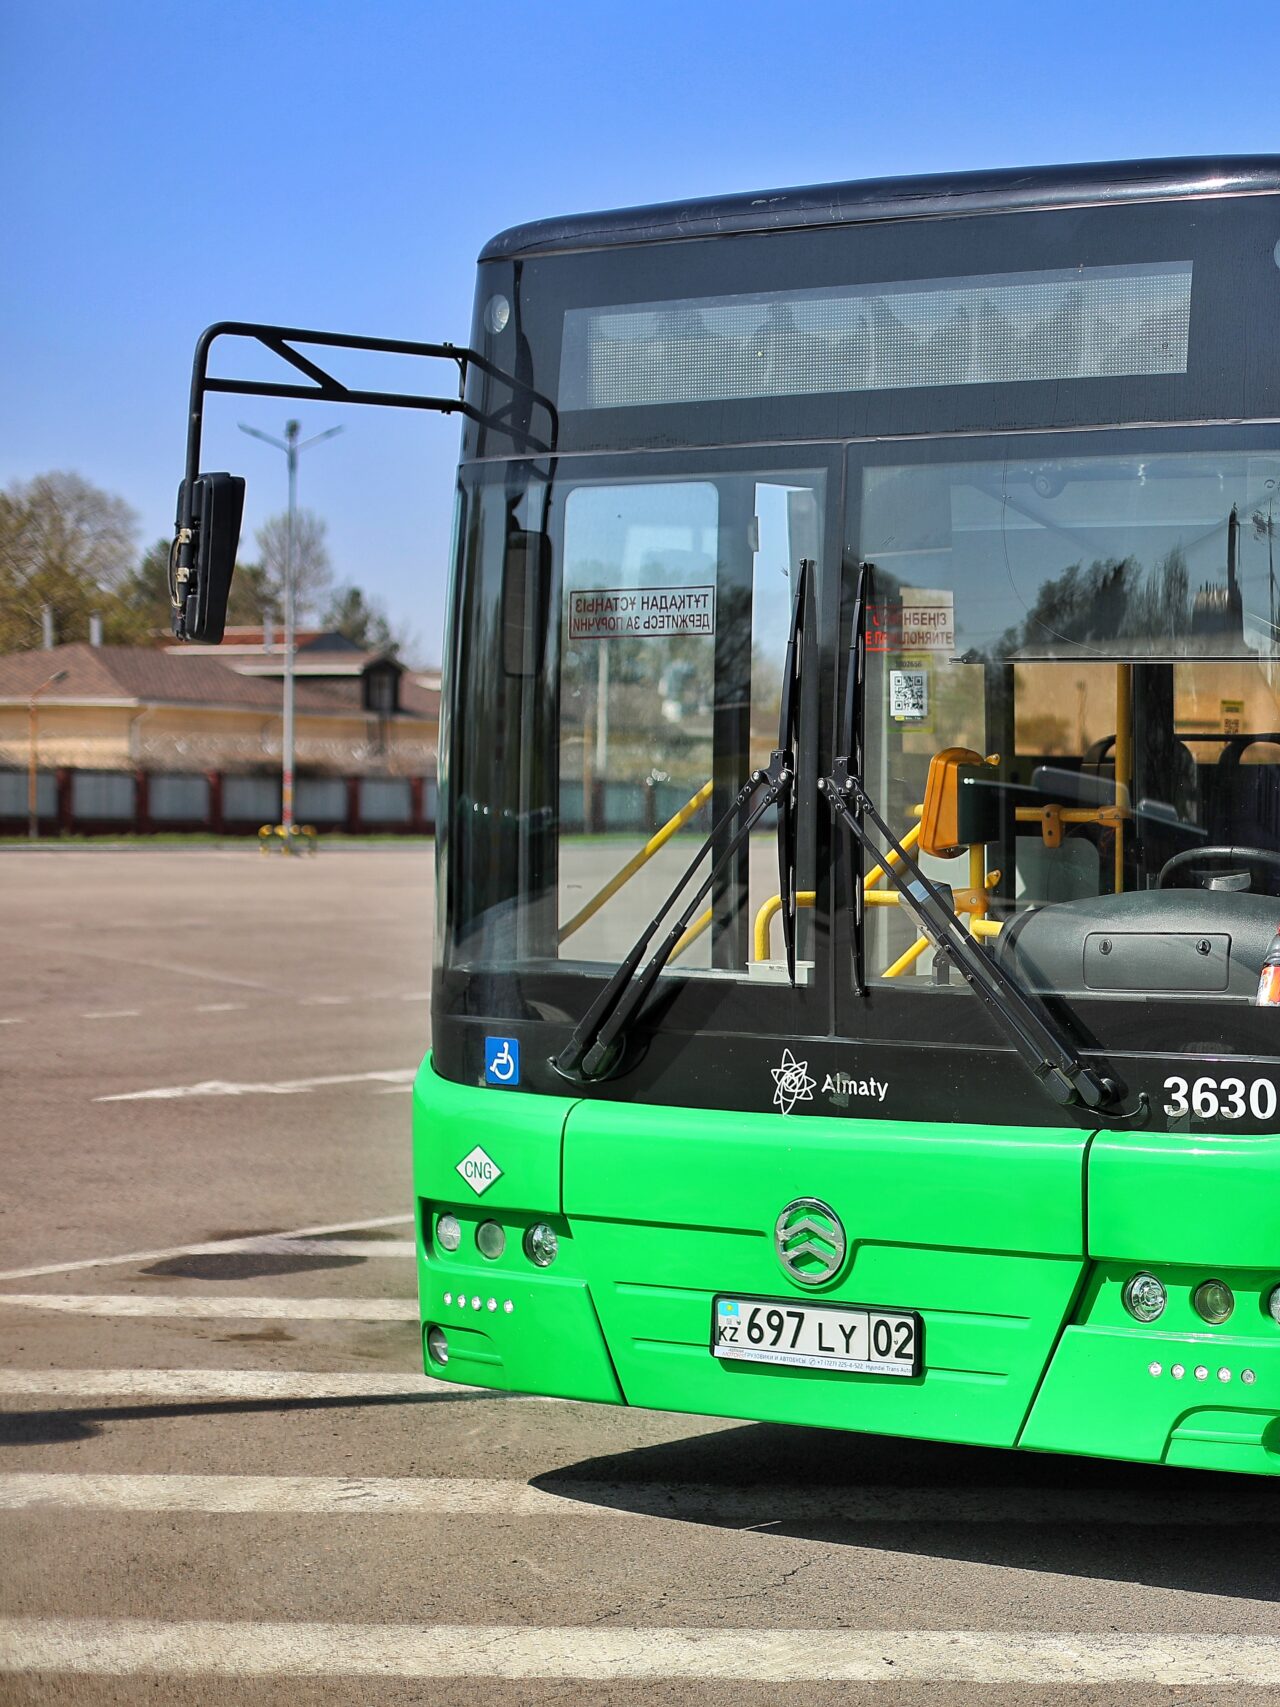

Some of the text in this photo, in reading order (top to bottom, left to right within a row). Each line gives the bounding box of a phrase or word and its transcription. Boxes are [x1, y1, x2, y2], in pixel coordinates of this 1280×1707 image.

[821, 1072, 889, 1102] Almaty
[1163, 1076, 1278, 1120] 3630
[464, 1161, 492, 1180] CNG
[718, 1326, 739, 1343] KZ
[747, 1307, 914, 1360] 697 LY 02
